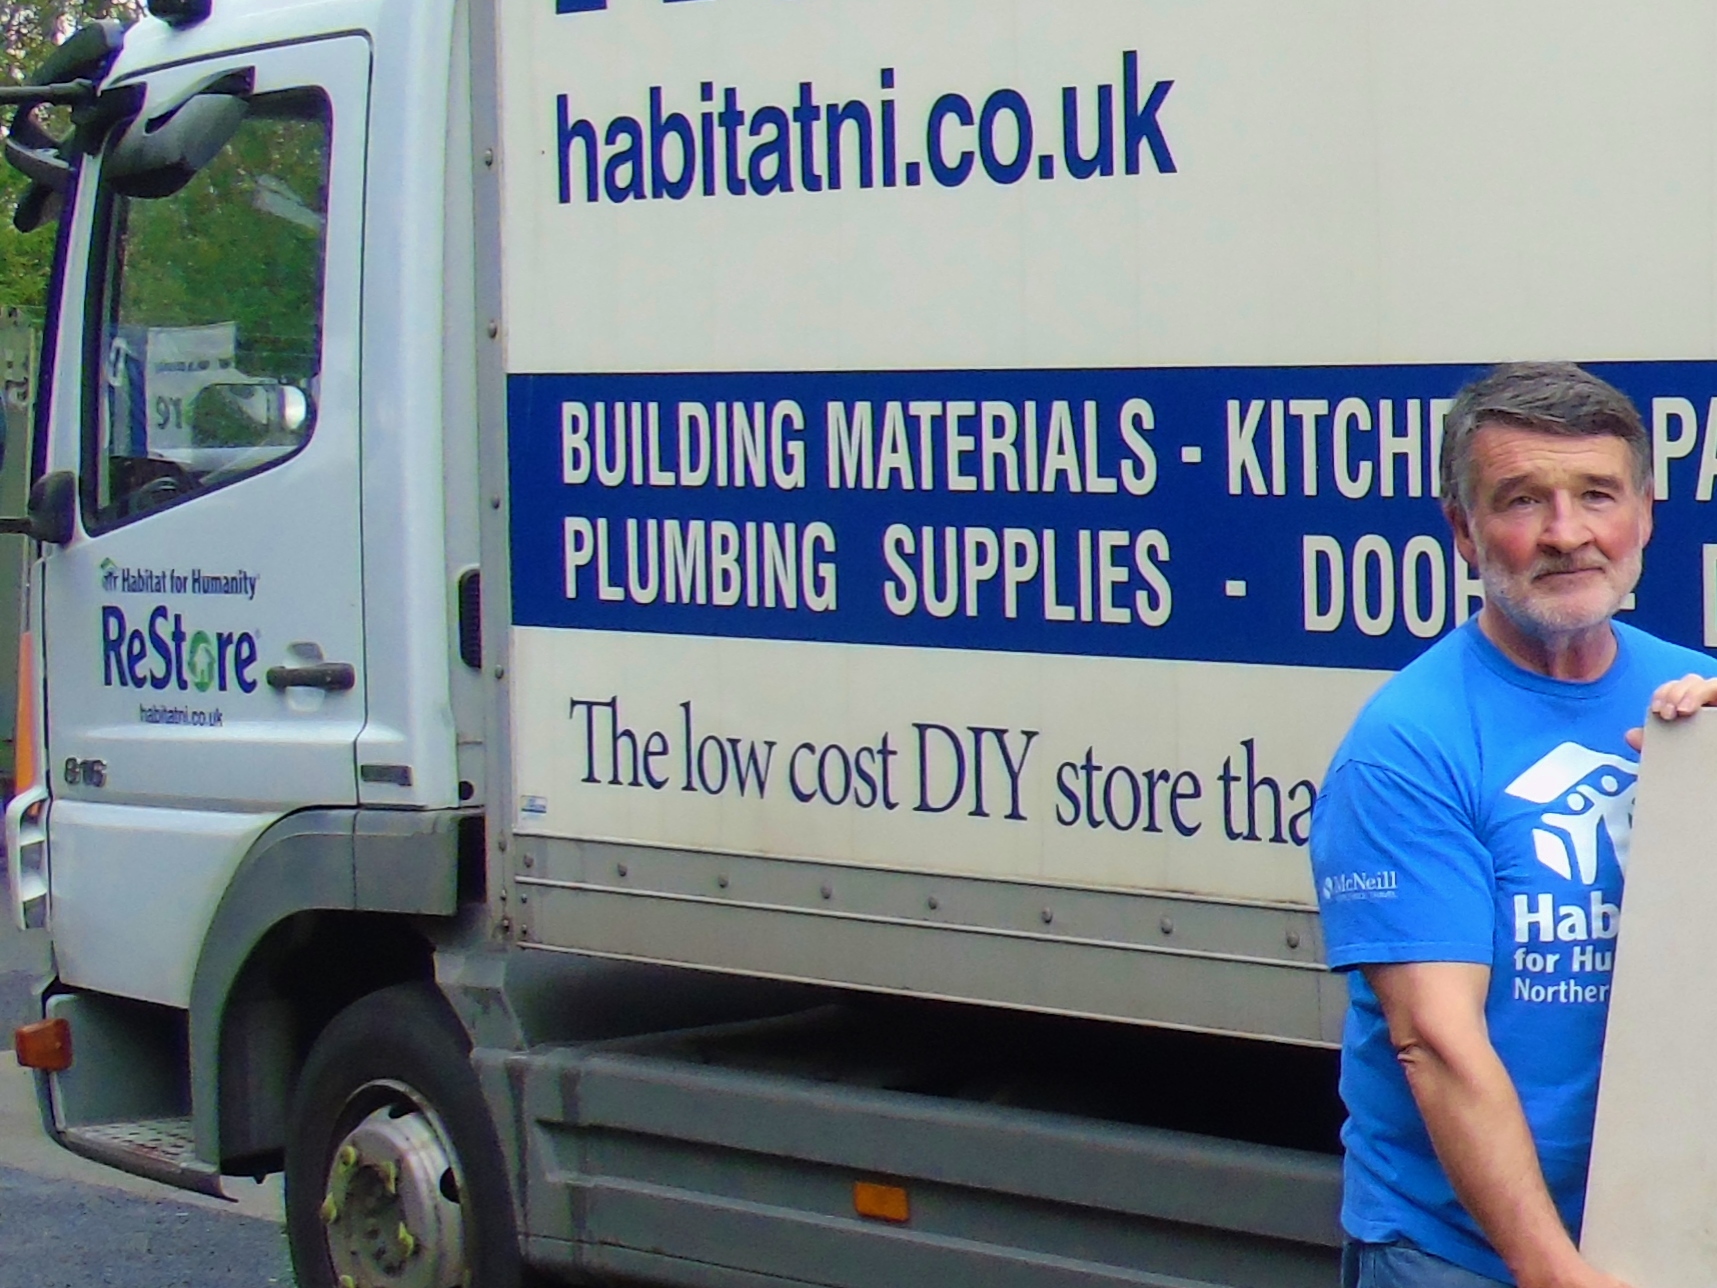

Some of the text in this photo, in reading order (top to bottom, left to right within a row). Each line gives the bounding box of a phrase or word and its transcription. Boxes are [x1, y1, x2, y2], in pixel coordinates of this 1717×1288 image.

[555, 49, 1178, 204] habitatni.co.uk
[560, 400, 806, 489] BUILDING
[826, 398, 1157, 497] MATERIALS
[122, 568, 166, 594] Habitat
[170, 569, 188, 594] for
[562, 517, 837, 613] PLUMBING
[883, 523, 1173, 628] SUPPLIES
[102, 605, 258, 694] ReStore
[140, 703, 223, 727] habitatni.co.uk
[569, 696, 670, 791] The
[681, 702, 778, 800] low
[788, 732, 900, 811] cost
[912, 723, 1040, 822] DIY
[1056, 746, 1202, 837] store
[1333, 871, 1397, 892] McNeill
[1513, 890, 1620, 943] Hab
[1514, 945, 1612, 973] for Hu
